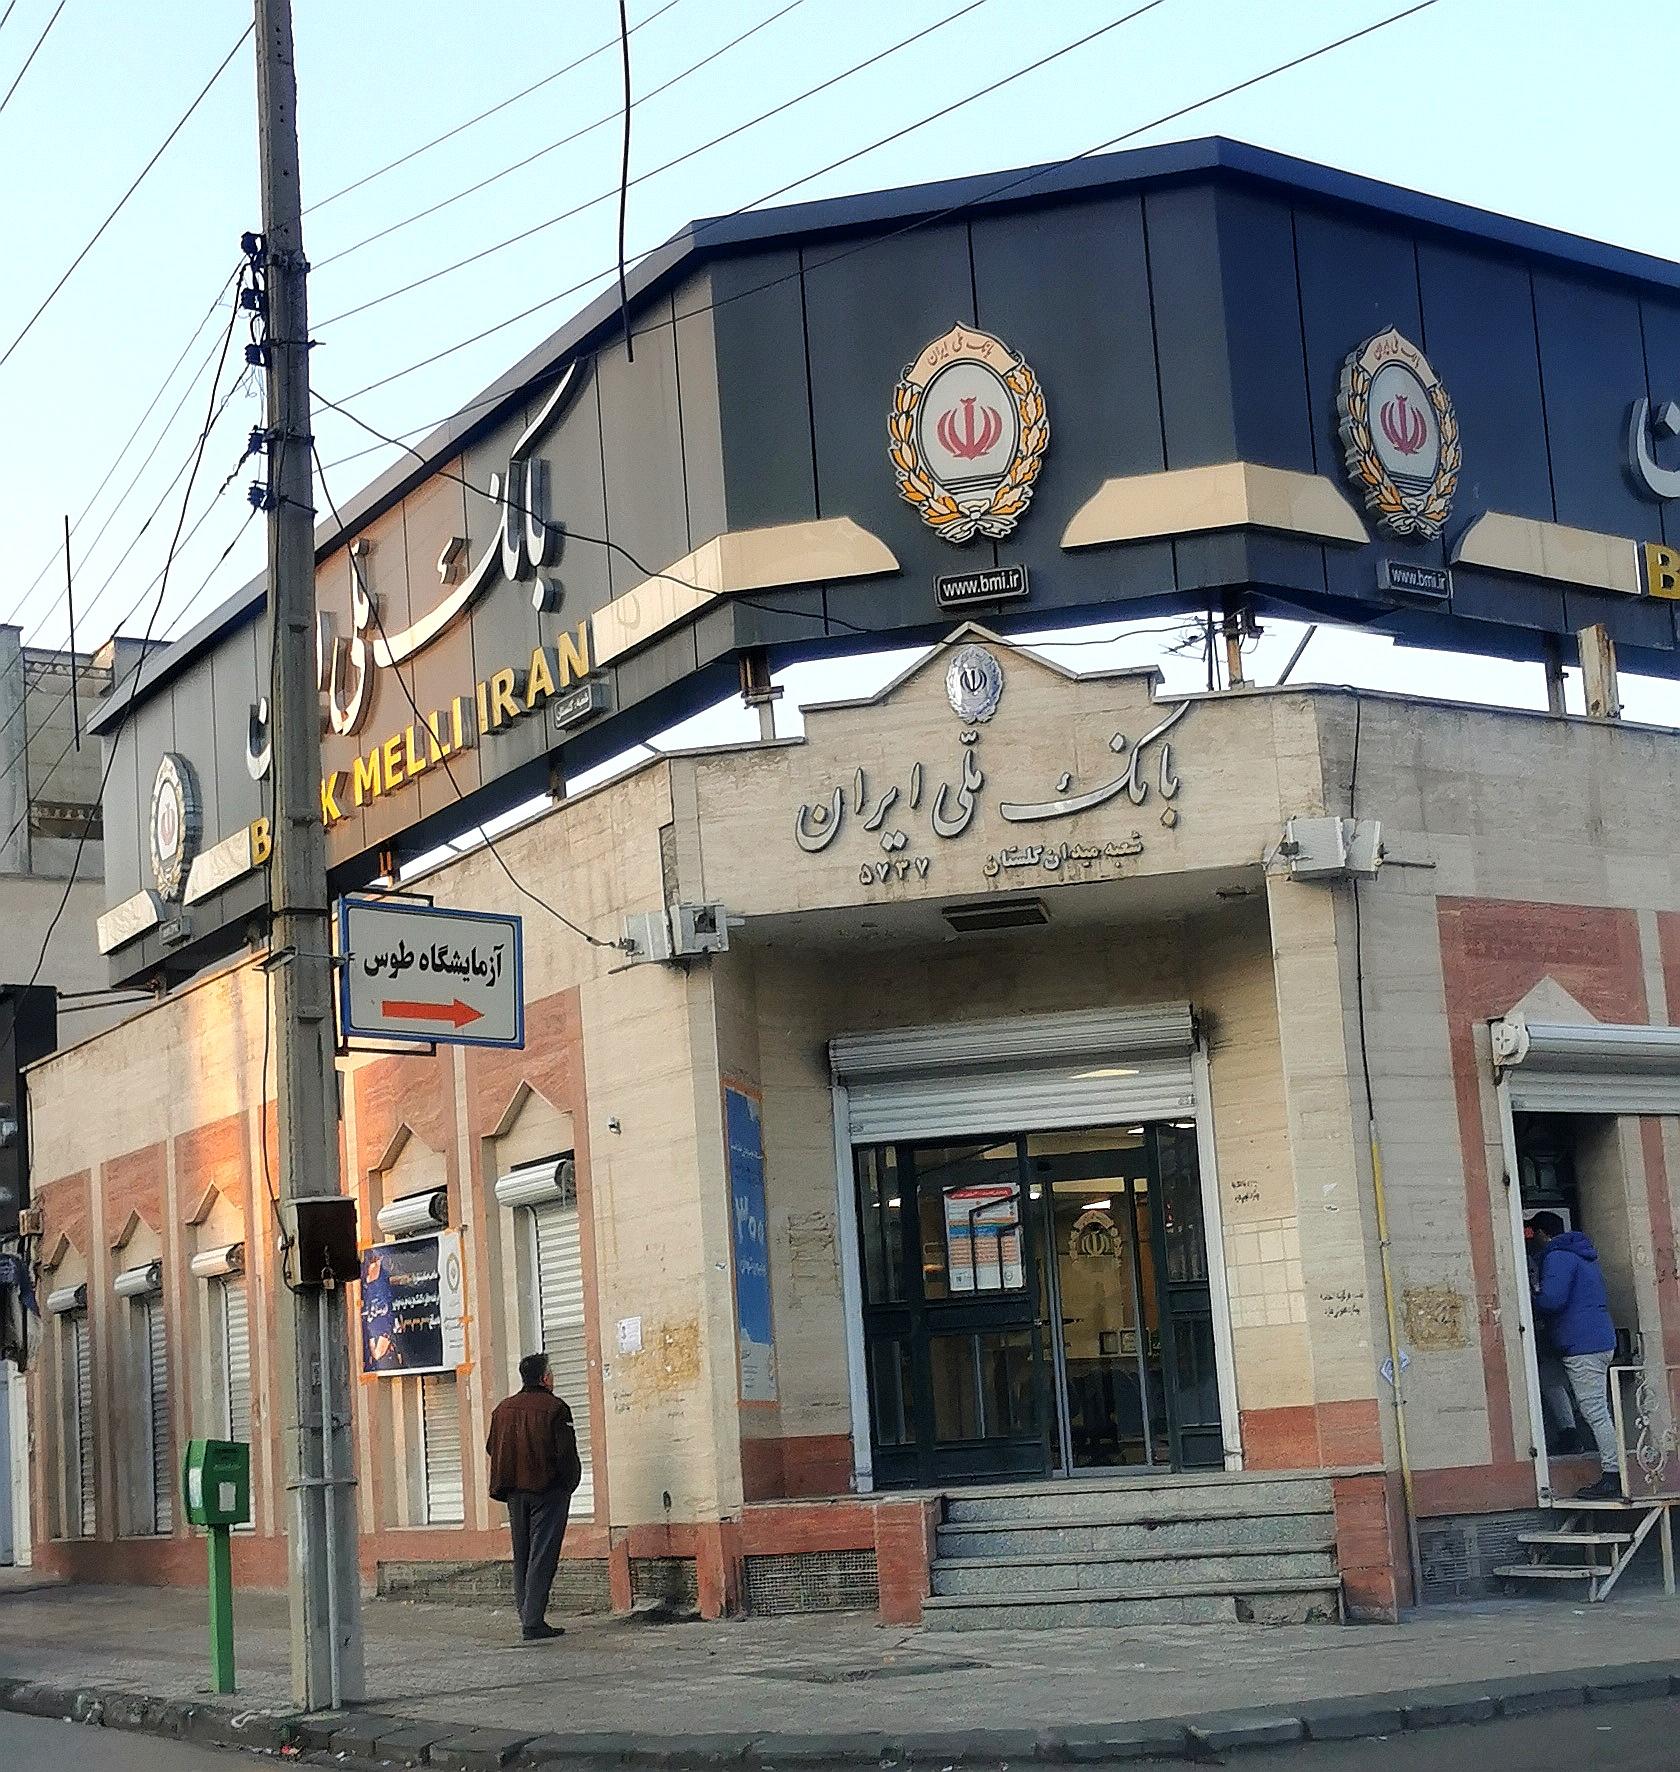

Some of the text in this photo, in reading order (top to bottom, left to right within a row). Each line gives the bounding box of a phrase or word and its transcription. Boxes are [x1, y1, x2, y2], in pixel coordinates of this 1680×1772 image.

[942, 570, 1020, 597] www.bmi.ir
[1391, 568, 1446, 590] www.bmi.ir
[352, 696, 464, 808] MELLI
[478, 620, 591, 736] IRAN
[1000, 699, 1191, 828] بانک
[795, 761, 924, 853] ایران
[858, 856, 930, 886] ۵۷۳۷
[982, 829, 1145, 877] شعبه میدان گلستان
[363, 939, 506, 987] آزمایشگاه طوس
